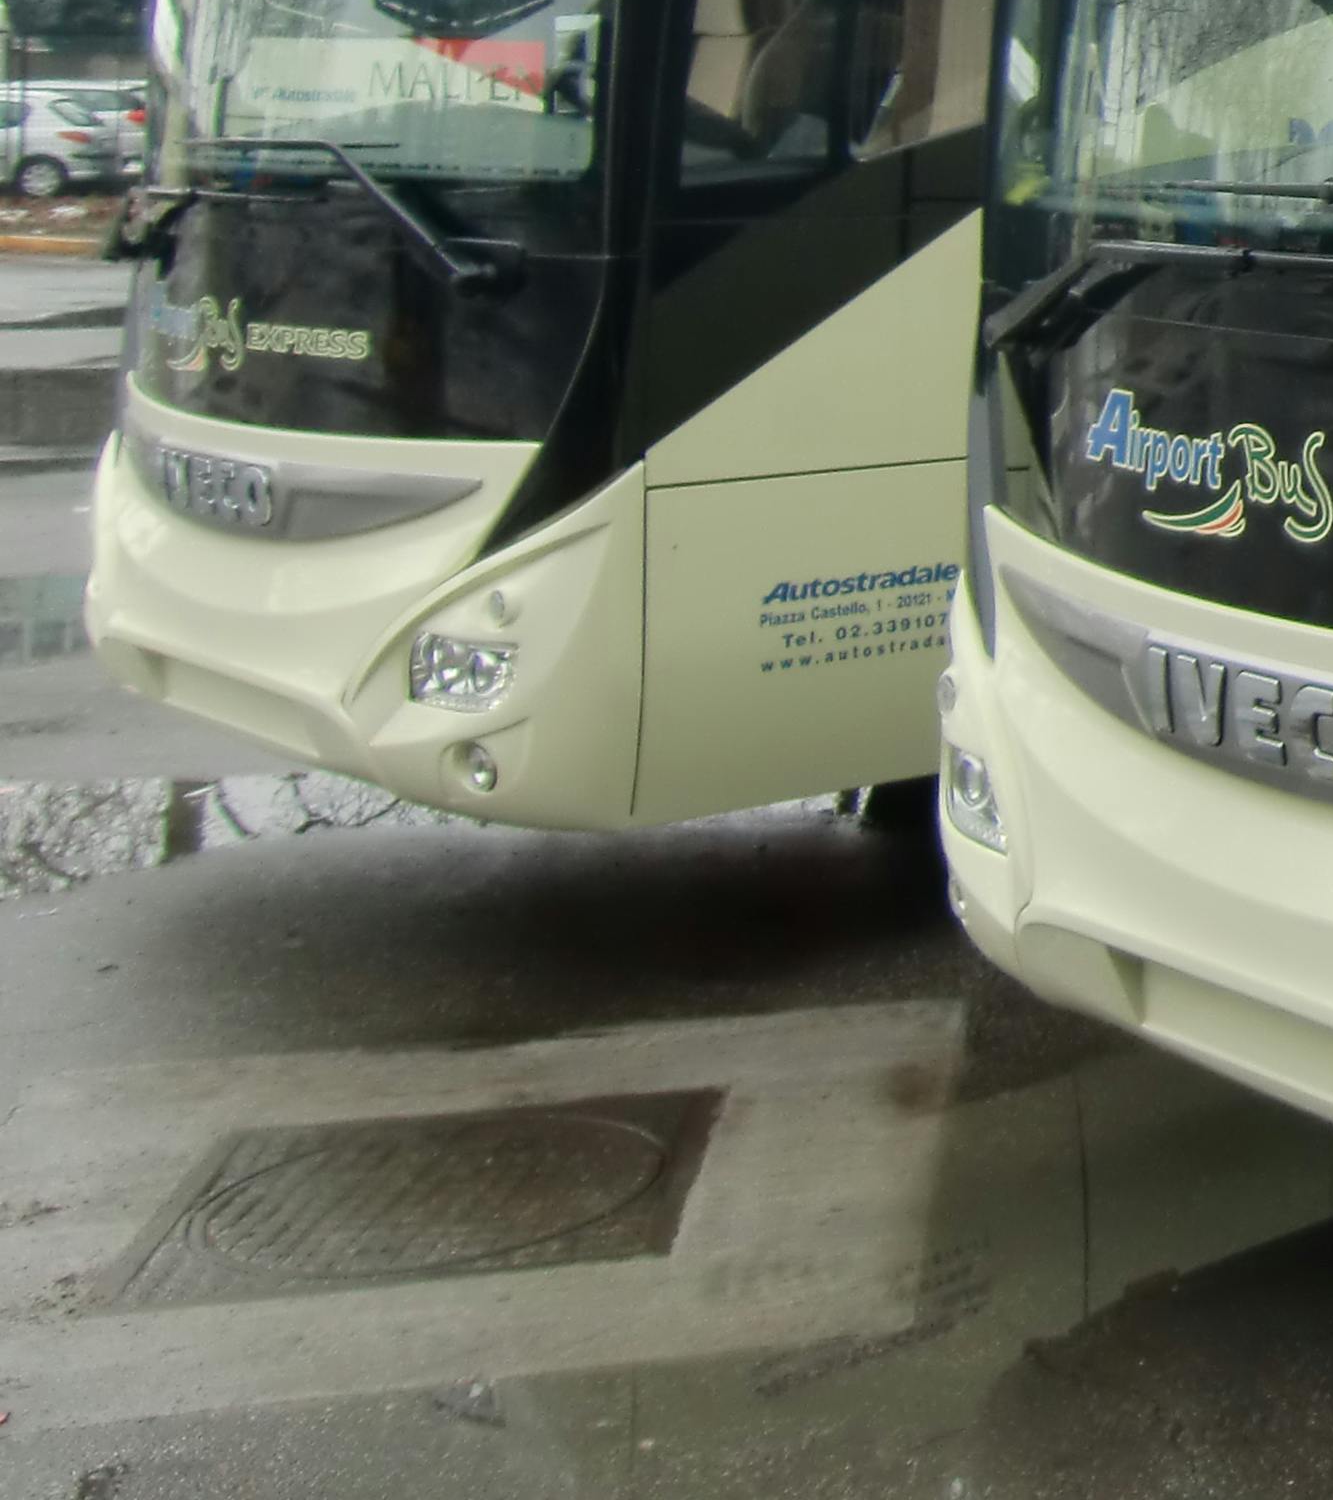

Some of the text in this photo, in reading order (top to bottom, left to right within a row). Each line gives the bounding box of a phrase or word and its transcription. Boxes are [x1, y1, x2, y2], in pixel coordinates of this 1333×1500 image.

[246, 322, 370, 360] EXPRESS
[1087, 388, 1226, 490] Airport
[157, 446, 273, 527] IVECO
[762, 561, 959, 605] Autostradale
[759, 612, 805, 628] Piazza
[896, 592, 932, 610] 20121
[782, 612, 948, 649] Tel. 02.339107
